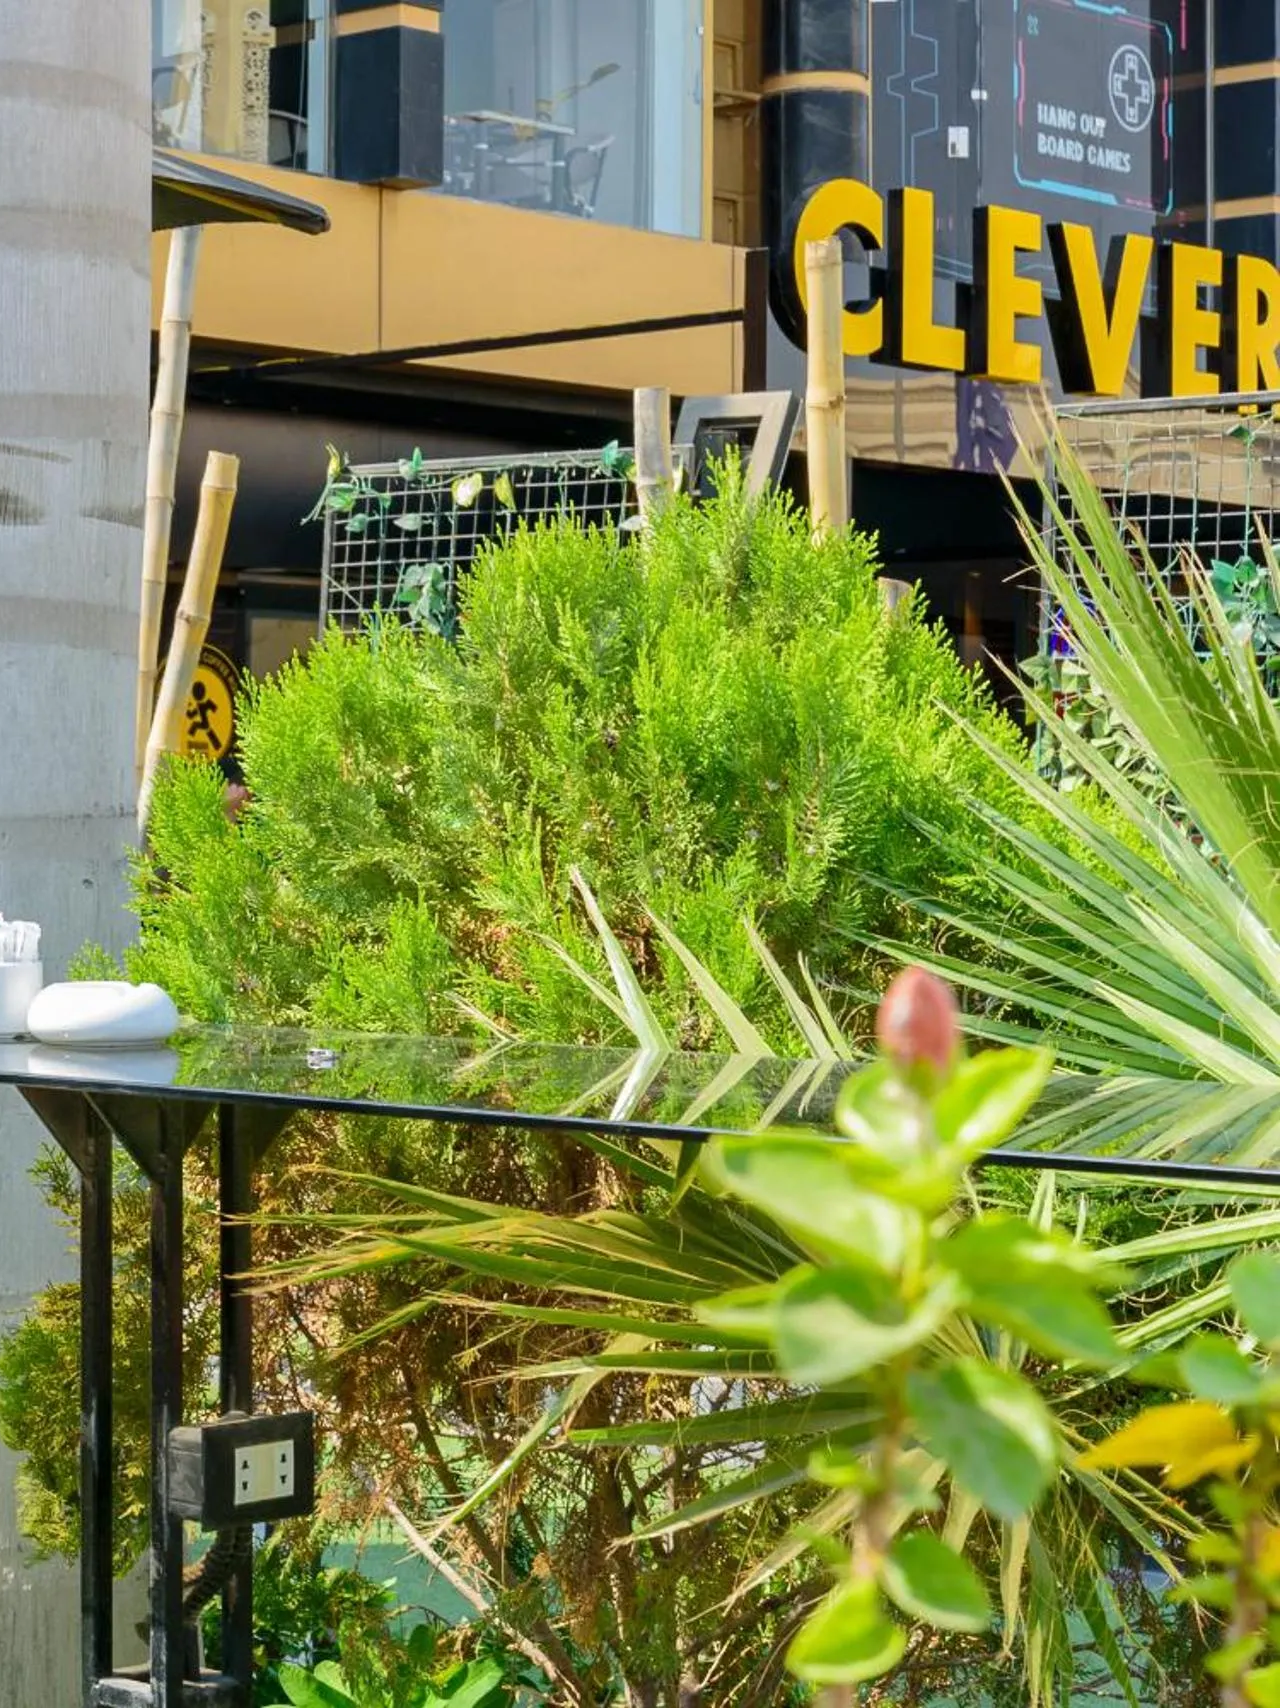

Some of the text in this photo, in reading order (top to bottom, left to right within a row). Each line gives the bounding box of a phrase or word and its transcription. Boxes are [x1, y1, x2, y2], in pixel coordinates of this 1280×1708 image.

[1037, 102, 1107, 138] HANG OUT
[1037, 132, 1131, 173] BOARD GAMES
[793, 177, 1280, 421] CLEVER
